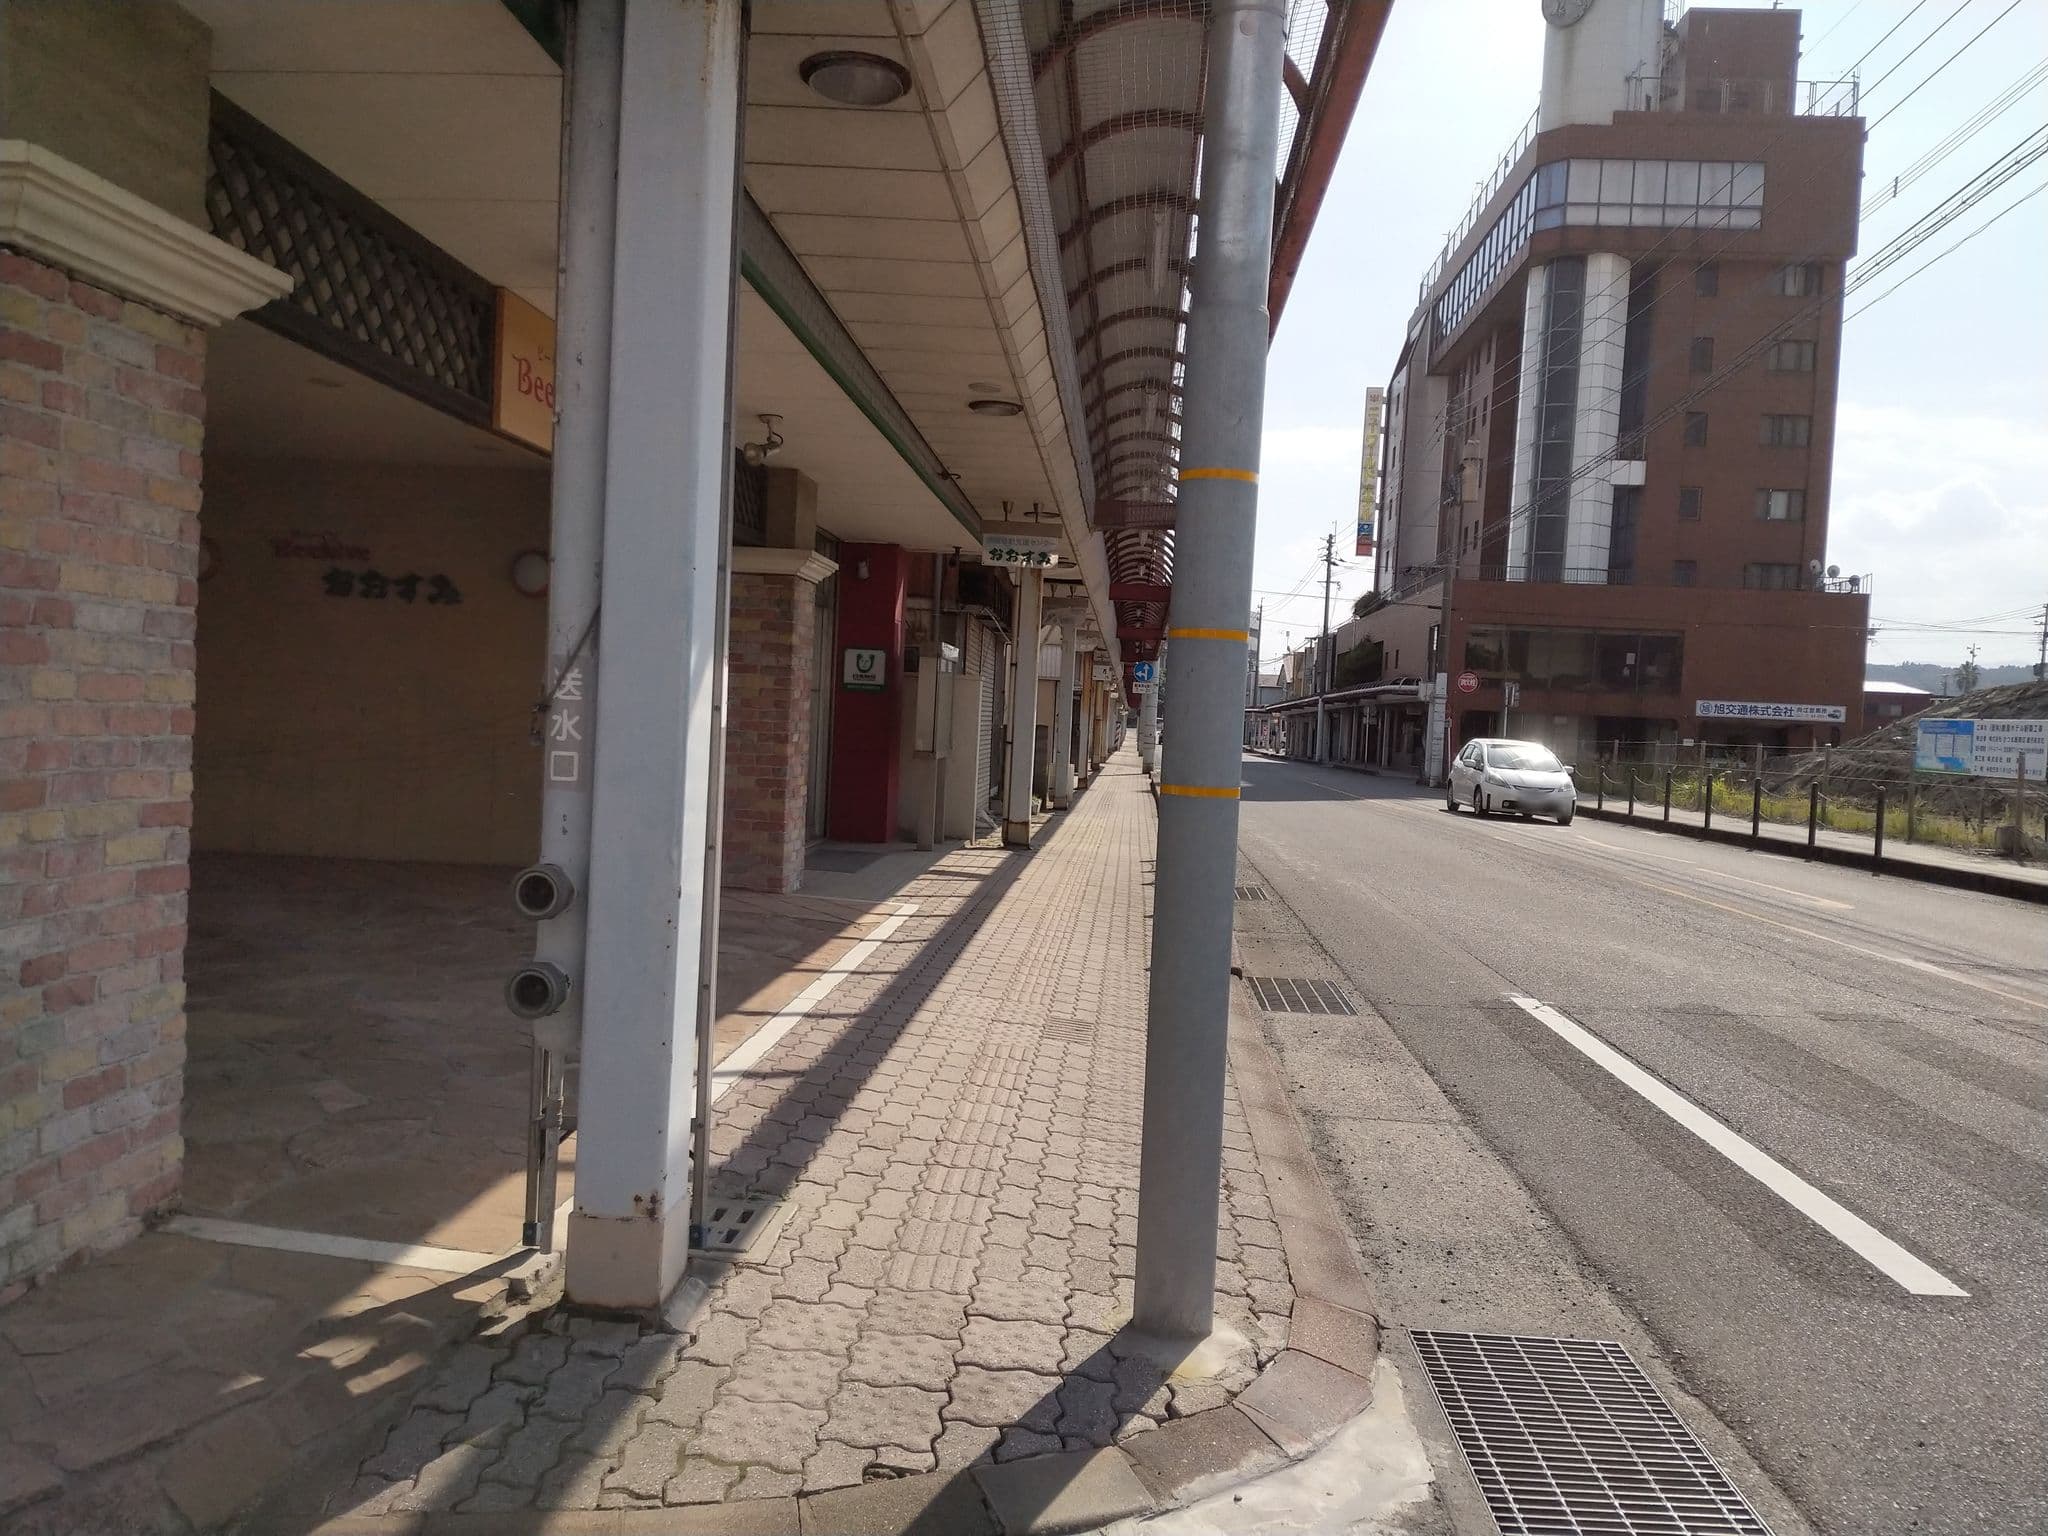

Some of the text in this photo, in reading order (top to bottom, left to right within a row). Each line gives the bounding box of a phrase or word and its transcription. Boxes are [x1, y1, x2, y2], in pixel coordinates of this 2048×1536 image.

[989, 547, 1051, 566] おおすみ
[321, 567, 463, 605] おおすみ
[1714, 703, 1795, 717] 旭交通株式会社
[550, 668, 583, 782] 送水口
